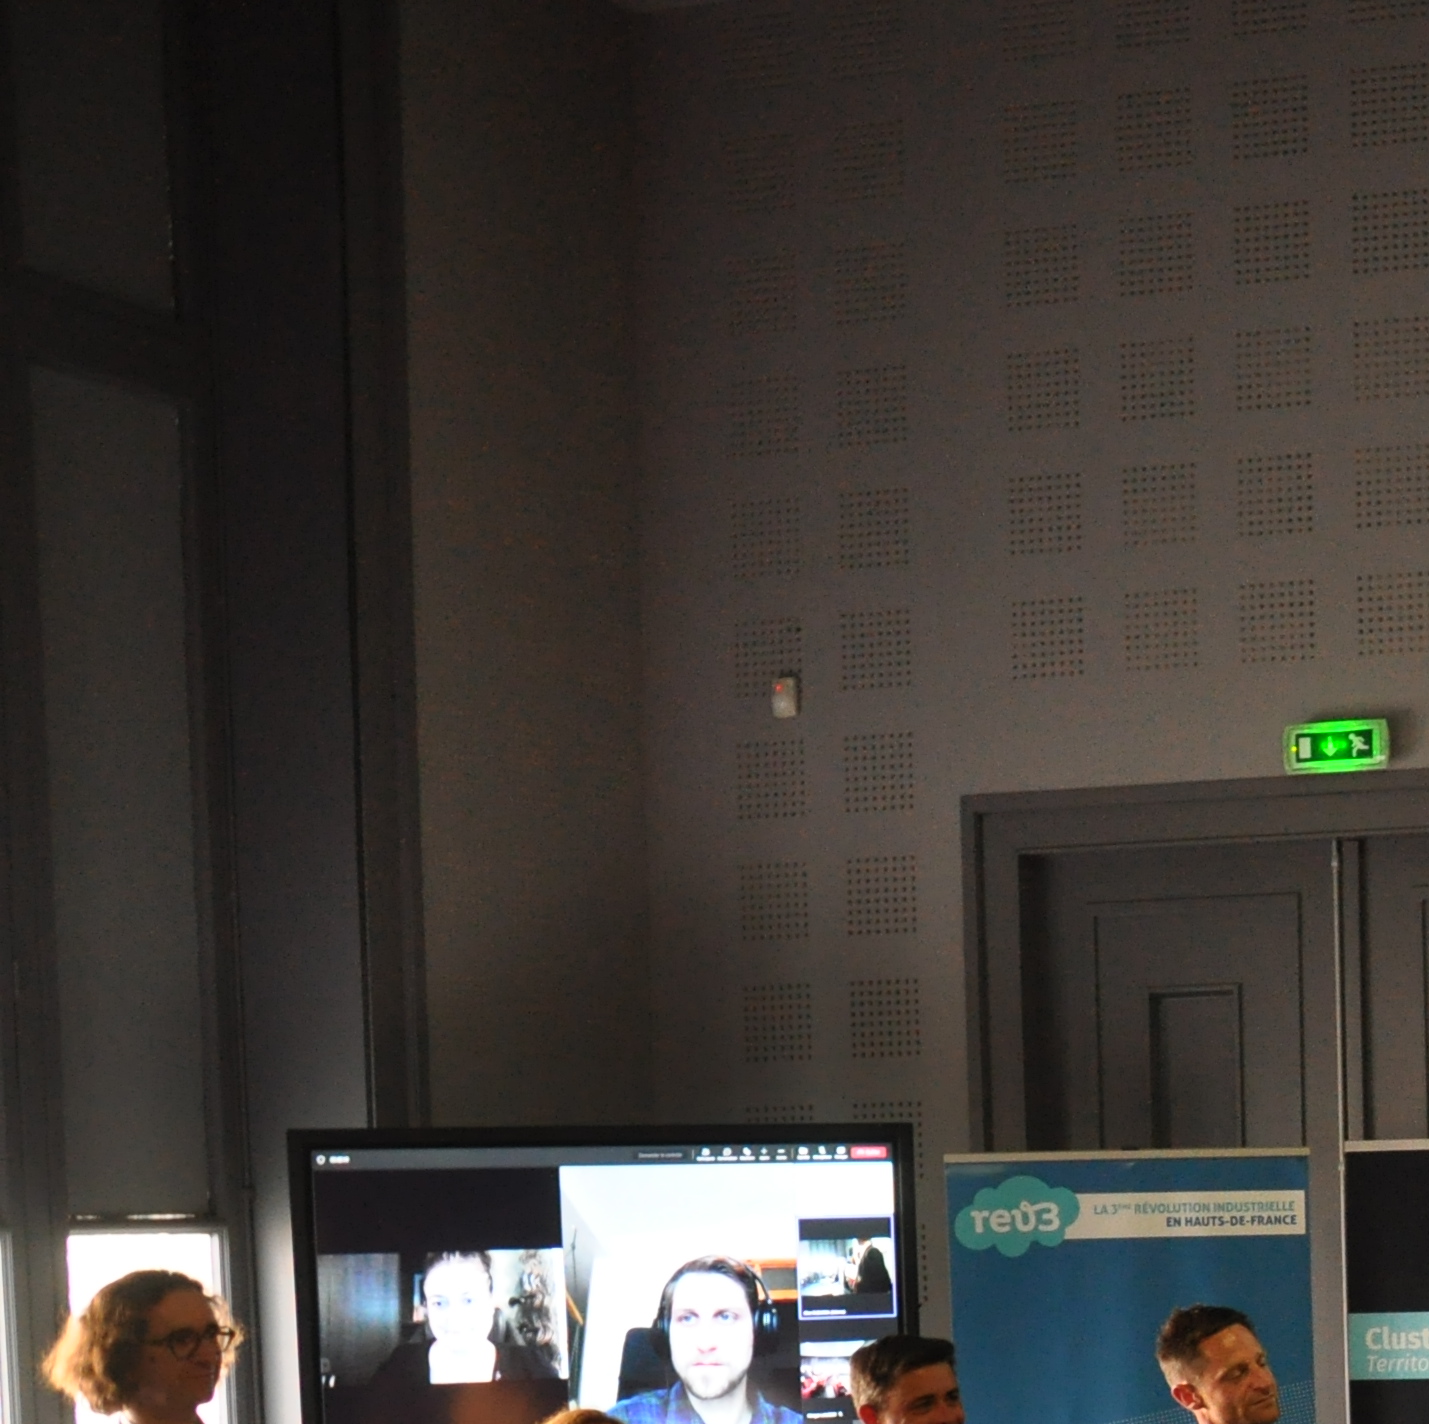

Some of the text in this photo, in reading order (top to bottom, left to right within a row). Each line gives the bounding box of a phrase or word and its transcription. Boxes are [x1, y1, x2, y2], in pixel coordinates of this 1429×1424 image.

[1093, 1204, 1109, 1216] LA
[1134, 1200, 1211, 1215] RÉVOLUTION
[1212, 1199, 1297, 1214] INDUSTRIELLE
[1165, 1213, 1298, 1228] EN HAUTS-DE-FRANCE
